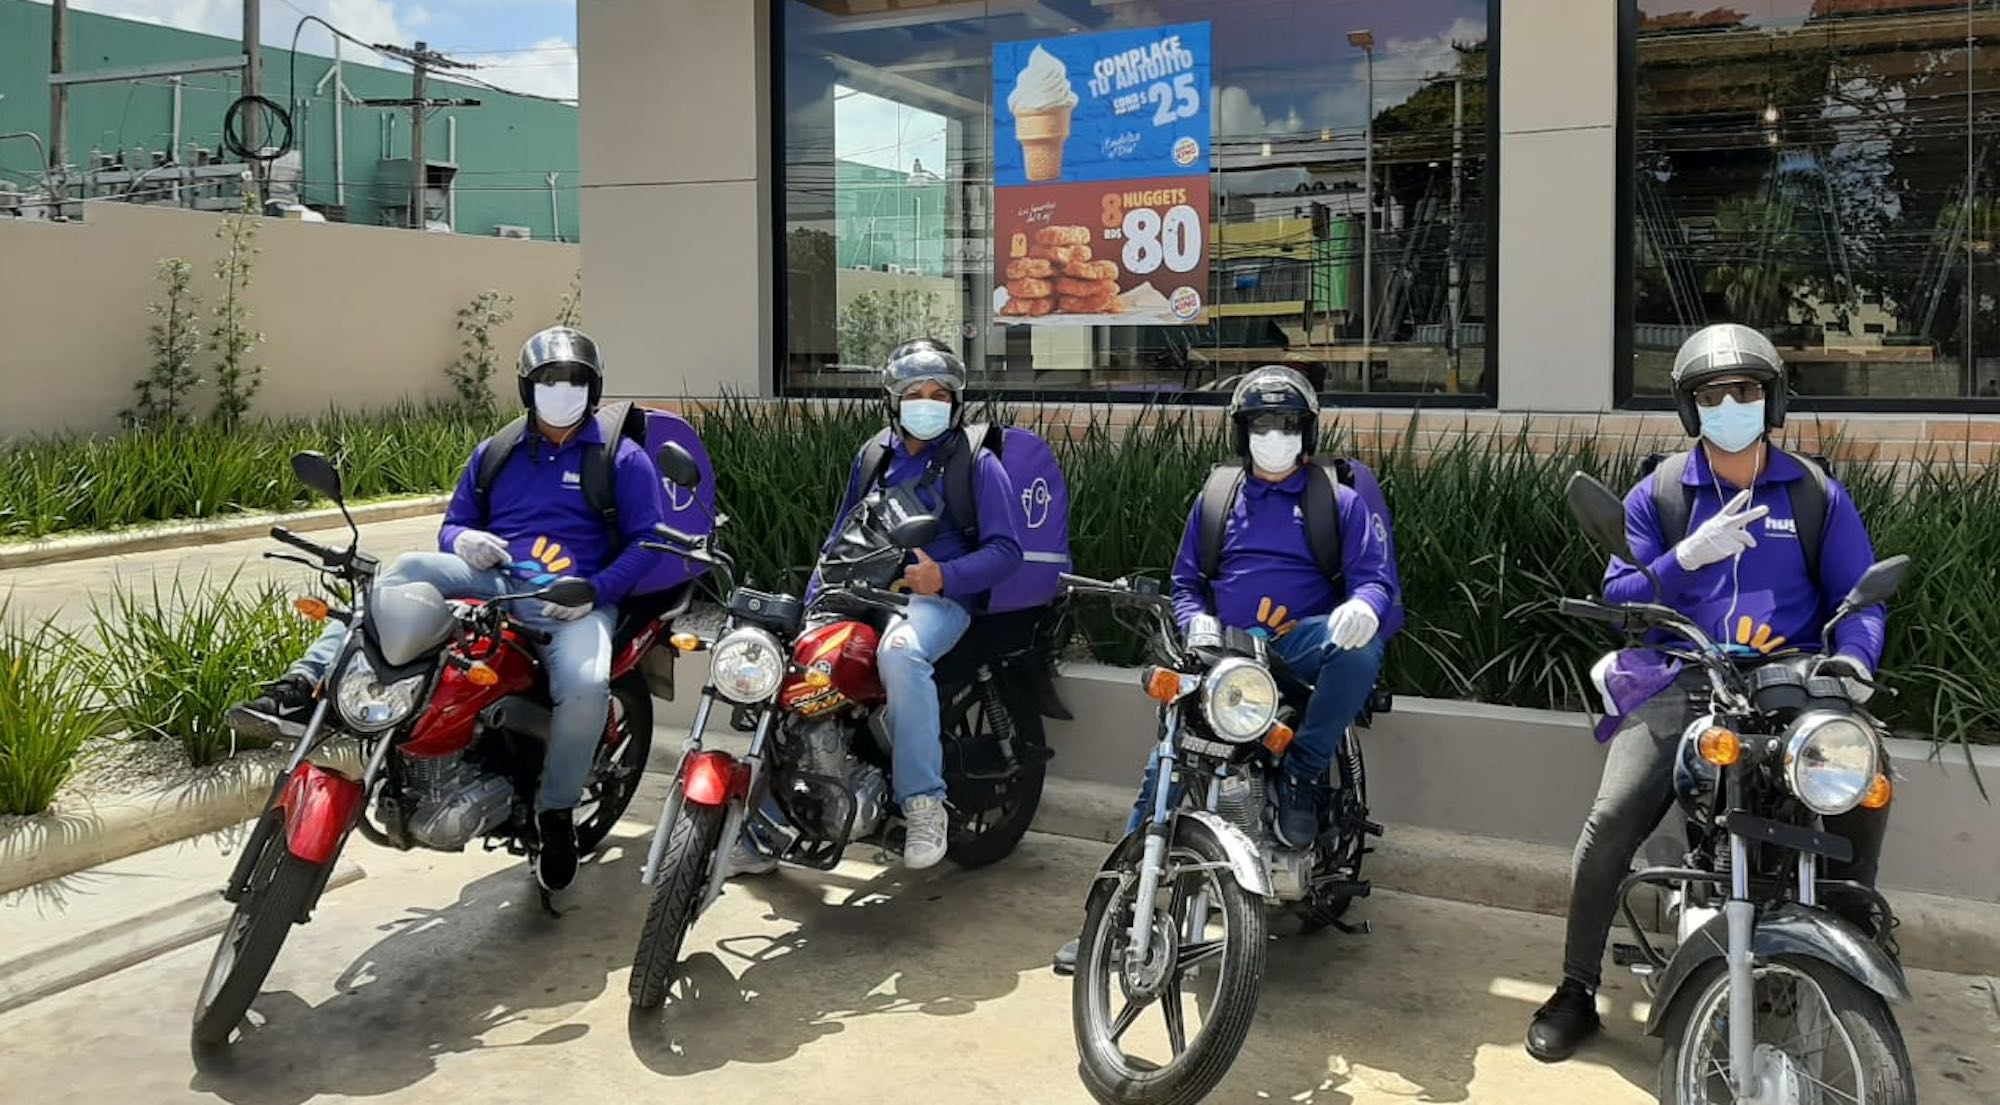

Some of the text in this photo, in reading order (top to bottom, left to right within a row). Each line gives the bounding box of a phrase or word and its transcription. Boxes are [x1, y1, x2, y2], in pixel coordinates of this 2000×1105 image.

[1093, 35, 1180, 78] COMPLACE
[1087, 76, 1111, 98] TU
[1148, 73, 1200, 127] 25
[1101, 188, 1186, 227] 8 NUGGETS
[1122, 205, 1201, 274] 80
